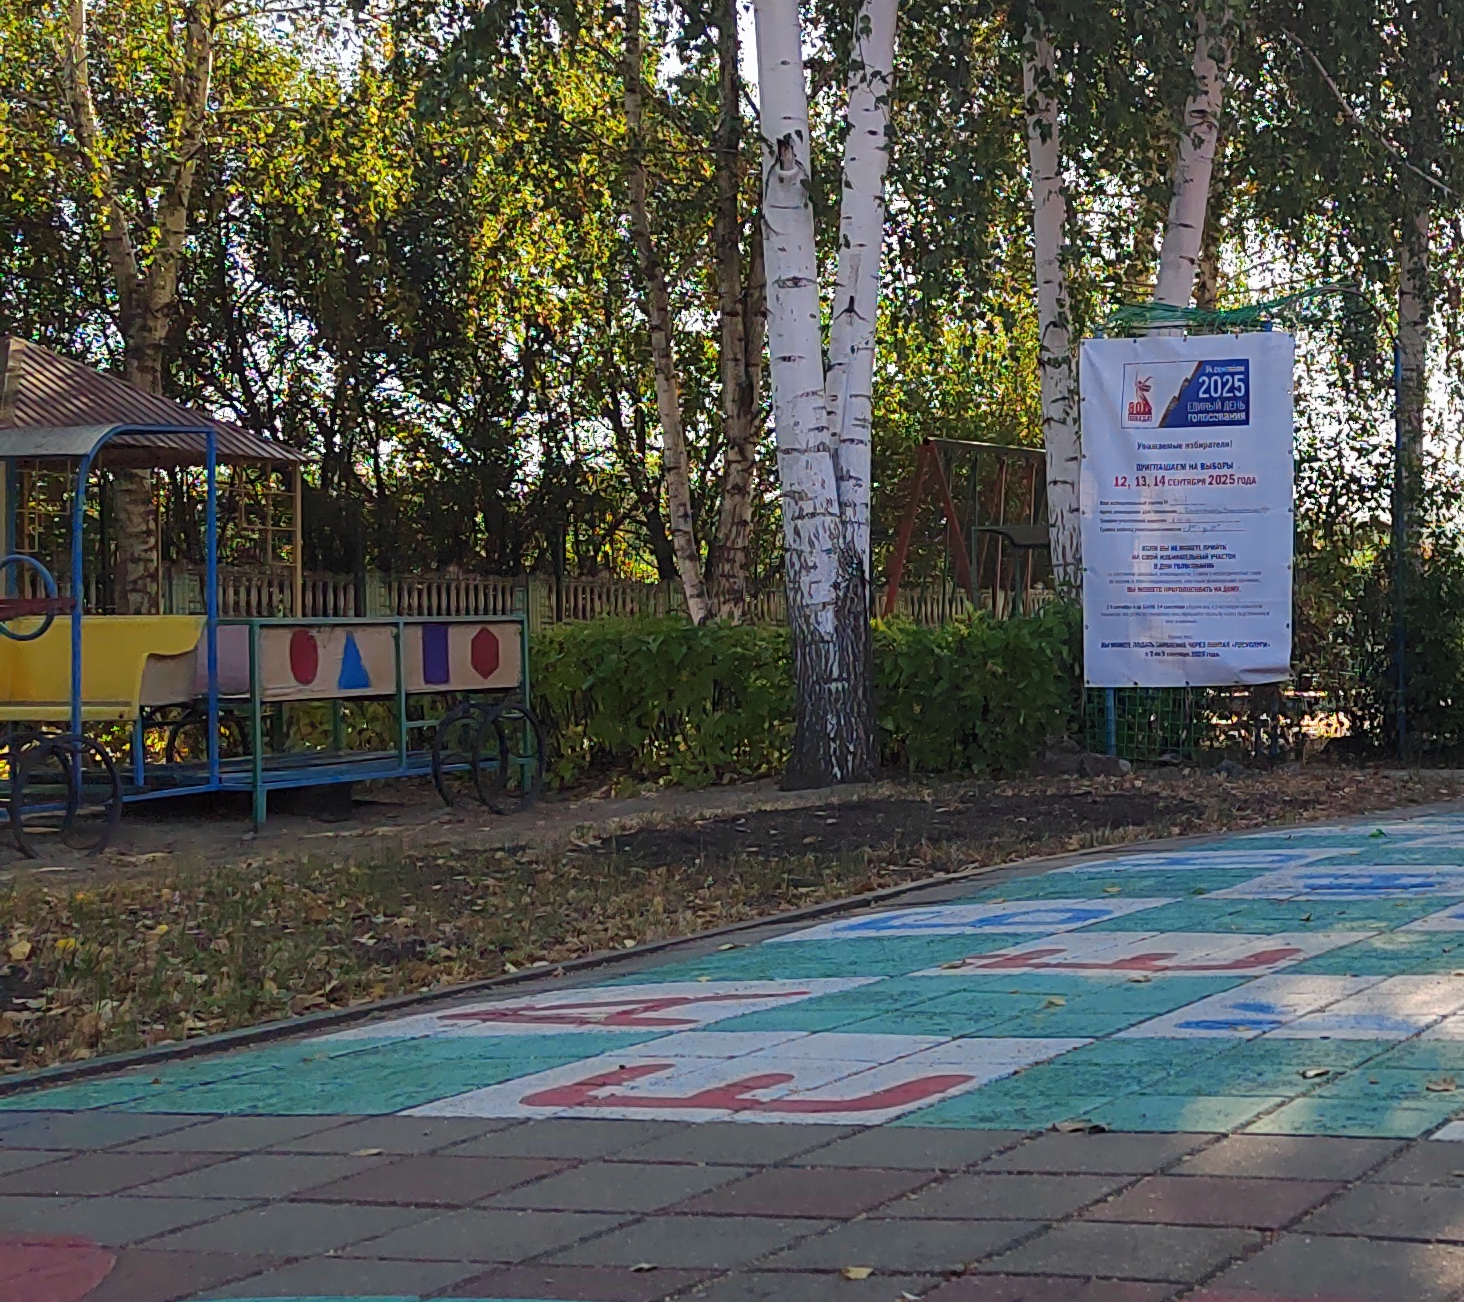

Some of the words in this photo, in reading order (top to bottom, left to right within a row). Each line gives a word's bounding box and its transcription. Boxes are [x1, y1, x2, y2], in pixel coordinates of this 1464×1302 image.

[1198, 375, 1245, 398] 2025
[1188, 400, 1222, 412] ЕДИНЫЙ
[1223, 400, 1246, 411] ДЕНЬ
[1188, 412, 1246, 422] ГОЛОСОВАНИЯ
[1136, 442, 1183, 451] Уважаемые
[1184, 440, 1233, 450] избиратели!
[1136, 463, 1187, 472] ПРИГЛАШАЕМ
[1188, 463, 1198, 471] НА
[1200, 461, 1234, 471] ВЫБОРЫ
[1114, 475, 1131, 489] 12,
[1135, 475, 1151, 488] 13,
[1153, 475, 1166, 487] 14
[1167, 478, 1206, 486] СЕНТЯБРЯ
[1208, 474, 1236, 486] 2025
[1237, 476, 1257, 485] ГОДА
[434, 989, 815, 1028] А
[517, 1062, 979, 1114] Е
